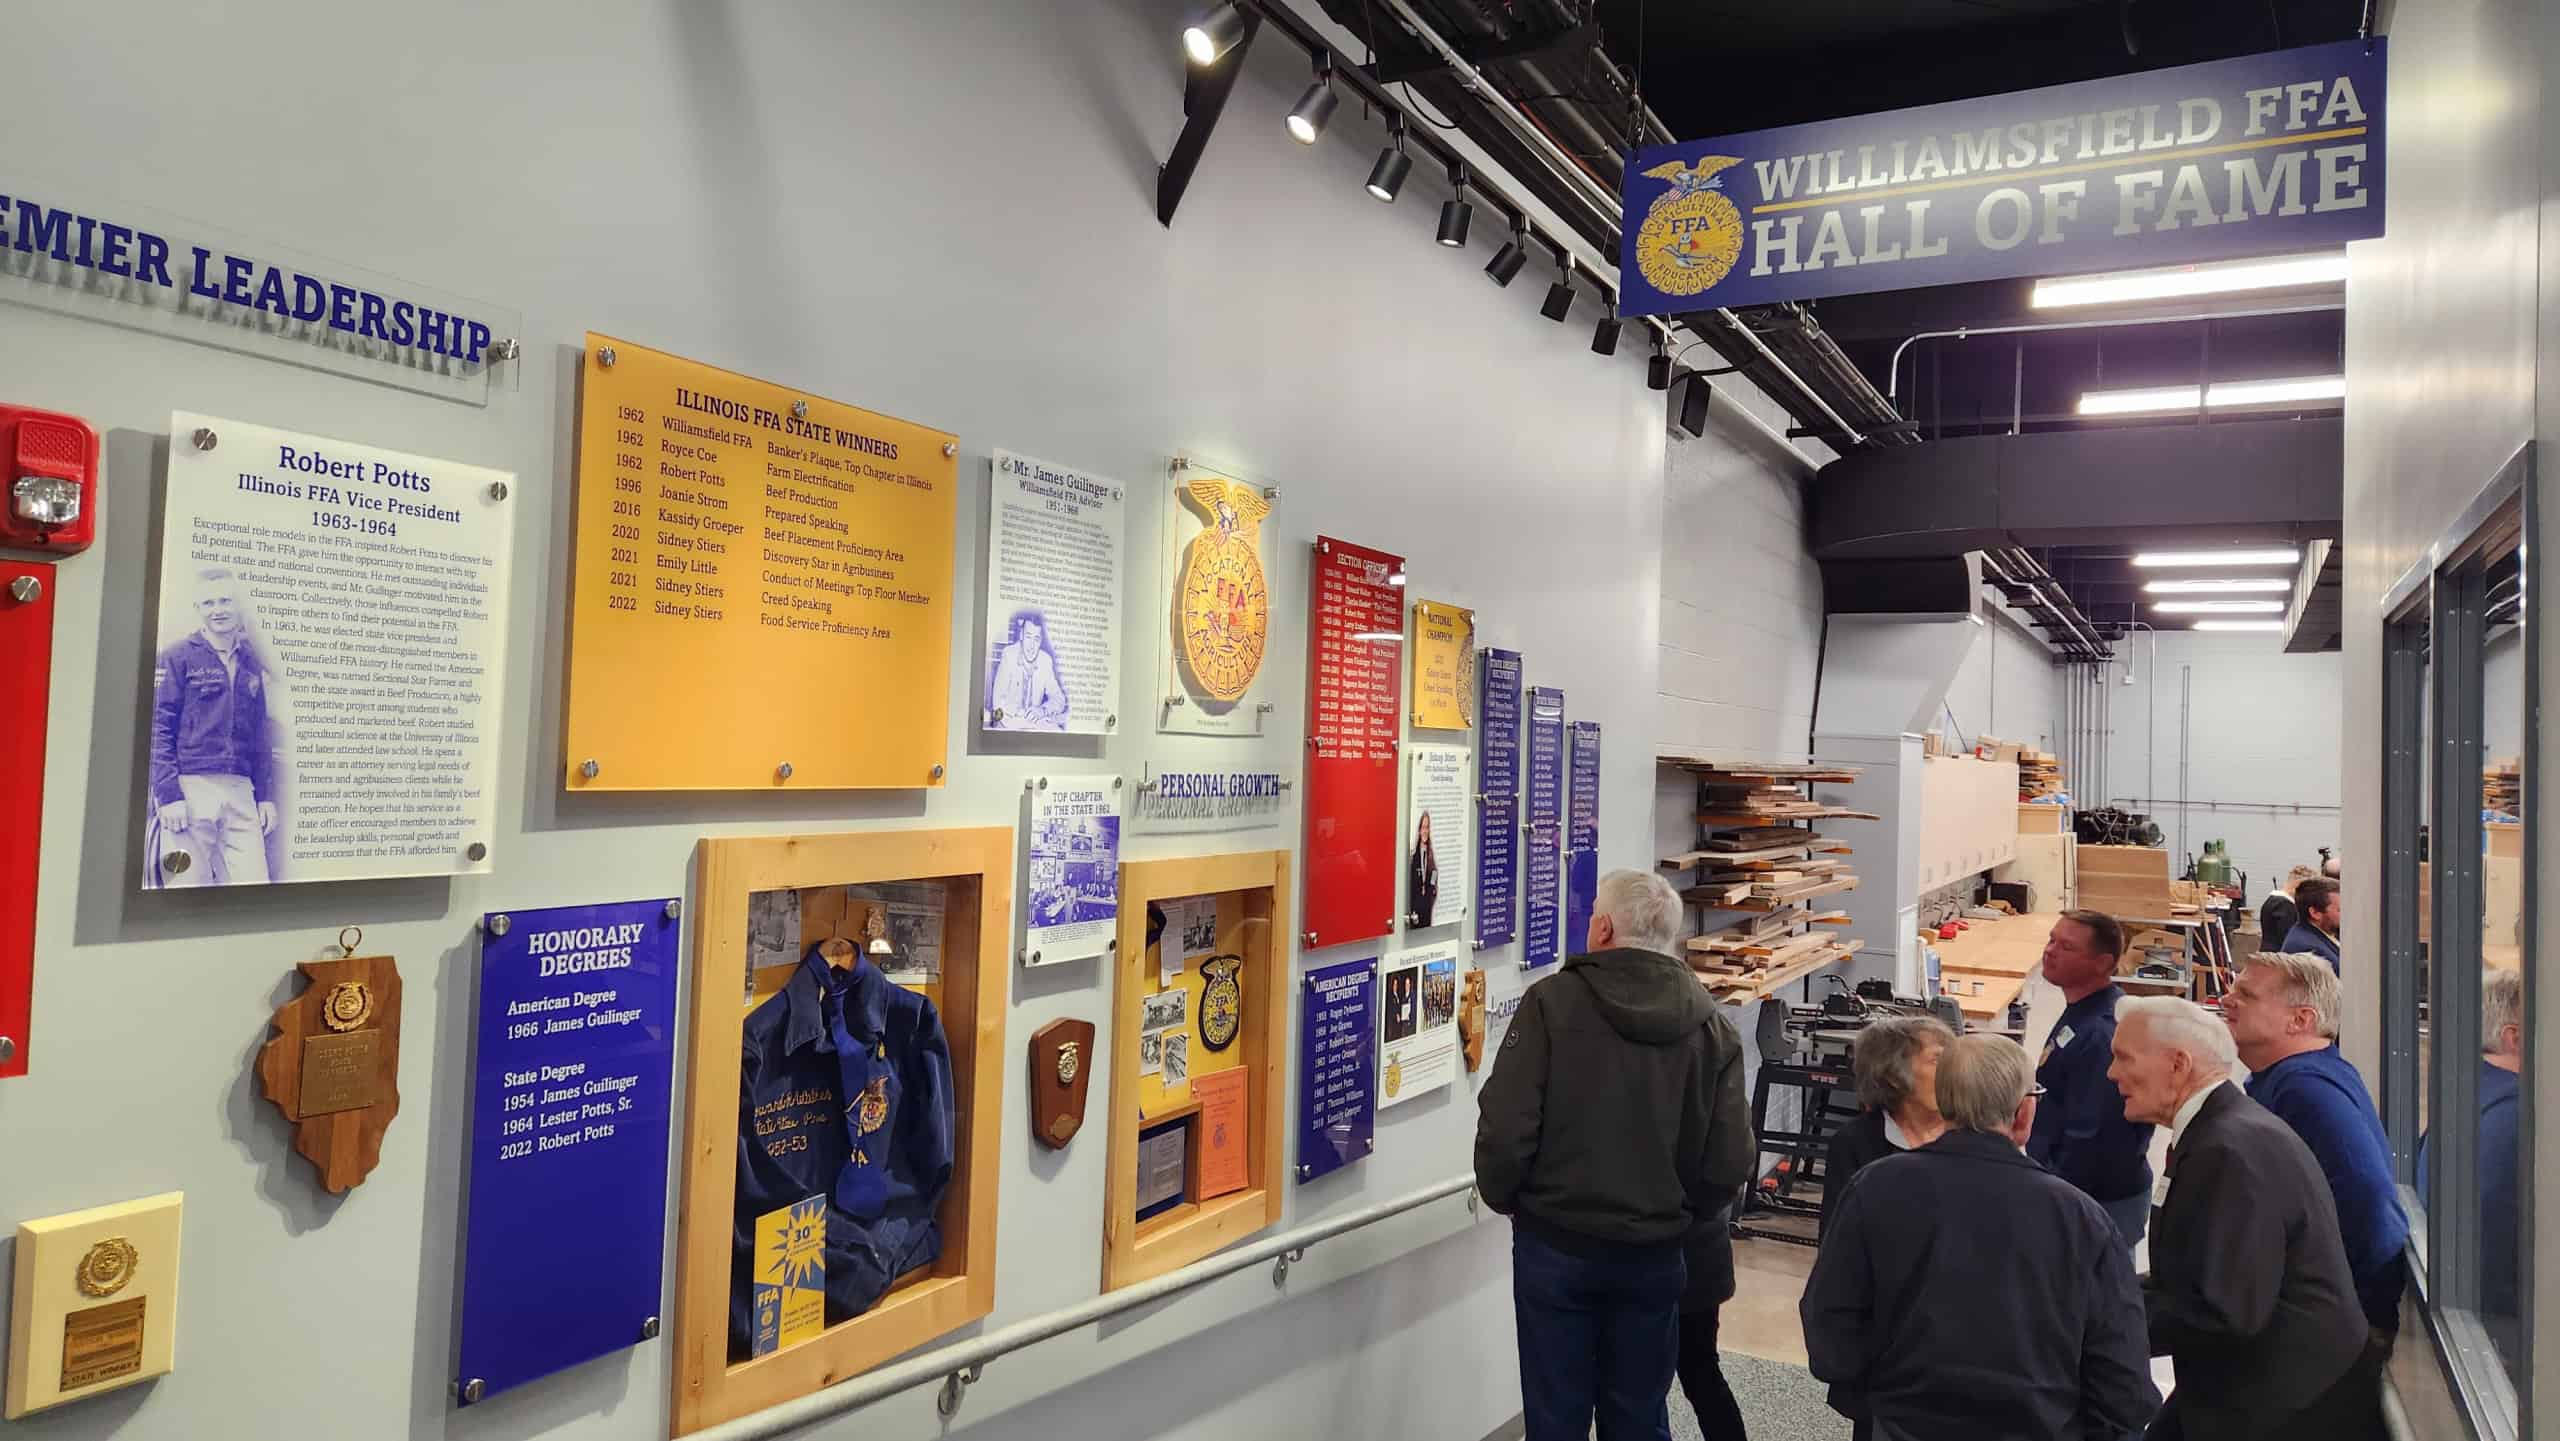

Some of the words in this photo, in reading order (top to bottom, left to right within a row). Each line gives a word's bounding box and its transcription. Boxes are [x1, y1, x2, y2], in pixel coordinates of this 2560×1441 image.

[1754, 97, 2224, 202] WILLIAMSFIELD
[2244, 76, 2367, 135] FFA
[1671, 216, 1711, 234] FFA
[1750, 200, 1949, 277] HALL
[1975, 180, 2086, 250] OF
[2112, 144, 2367, 236] FAME
[190, 246, 491, 363] LEADERSHIP
[676, 388, 749, 422] ILLINOIS
[754, 408, 781, 430] FFA
[785, 416, 831, 443] STATE
[835, 430, 898, 460] WINNERS
[617, 430, 643, 446] 1962
[662, 439, 694, 458] Royce
[697, 448, 717, 463] Coe
[768, 463, 790, 479] Farm
[794, 469, 854, 492] Electrification
[618, 406, 644, 423] 1962
[663, 415, 730, 444] Williamsfield
[733, 433, 752, 448] FFA
[768, 441, 807, 462] Banker's
[810, 451, 842, 470] Plaque,
[845, 460, 860, 474] Top
[864, 464, 895, 483] Chapter
[897, 472, 905, 483] in
[907, 475, 933, 491] Illinois
[278, 445, 364, 482] Robert
[373, 462, 431, 493] Potts
[616, 453, 642, 470] 1962
[660, 462, 696, 481] Robert
[700, 471, 725, 487] Potts
[766, 484, 787, 498] Beef
[789, 489, 838, 510] Production
[1014, 460, 1031, 477] Mr.
[1034, 466, 1064, 486] James
[1067, 474, 1108, 498] Guilinger
[238, 474, 301, 499] Illinois
[308, 485, 340, 505] FFA
[347, 491, 382, 512] Vice
[388, 498, 460, 522] President
[616, 477, 641, 493] 1996
[659, 485, 694, 504] Joanie
[698, 493, 728, 510] Strom
[765, 506, 806, 525] Prepared
[809, 514, 849, 535] Speaking
[194, 517, 250, 534] Exceptional
[253, 526, 270, 537] role
[273, 529, 305, 541] models
[308, 534, 316, 544] in
[319, 535, 332, 544] the
[335, 537, 352, 547] FFA
[311, 512, 397, 537] 1963-1964
[613, 500, 641, 517] 2016
[658, 508, 700, 530] Kassidy
[703, 516, 744, 535] Groeper
[764, 528, 784, 542] Beef
[788, 533, 834, 551] Placement
[837, 540, 883, 560] Proficiency
[886, 550, 904, 562] Area
[193, 533, 207, 544] full
[257, 541, 274, 552] The
[278, 544, 296, 555] FFA
[298, 550, 319, 558] gave
[321, 550, 337, 560] him
[340, 553, 354, 562] the
[405, 562, 413, 570] to
[612, 524, 640, 540] 2020
[658, 531, 694, 550] Sidney
[697, 538, 726, 554] Stiers
[764, 549, 809, 569] Discovery
[812, 557, 828, 569] Star
[832, 560, 839, 572] in
[843, 563, 894, 580] Agribusiness
[610, 572, 637, 587] 2021
[656, 578, 692, 597] Sidney
[695, 583, 723, 598] Stiers
[762, 592, 788, 606] Creed
[791, 595, 832, 615] Speaking
[612, 548, 638, 564] 2021
[657, 555, 687, 574] Emily
[691, 560, 718, 575] Little
[762, 570, 800, 586] Conduct
[804, 577, 814, 588] of
[816, 578, 854, 597] Meetings
[857, 584, 872, 599] Top
[875, 587, 896, 600] Floor
[898, 590, 930, 605] Member
[1217, 578, 1245, 608] FFA
[609, 595, 637, 610] 2022
[655, 601, 691, 619] Sidney
[694, 606, 723, 620] Stiers
[761, 613, 784, 626] Food
[787, 616, 819, 631] Service
[822, 620, 869, 639] Proficiency
[872, 627, 890, 639] Area
[1053, 793, 1068, 802] TOP
[1069, 792, 1102, 802] CHAPTER
[1161, 774, 1225, 797] PERSONAL
[1230, 774, 1279, 797] GROWTH
[1044, 806, 1051, 816] IN
[1055, 806, 1068, 815] THE
[1071, 805, 1092, 815] STATE
[528, 924, 644, 954] HONORARY
[540, 948, 632, 977] DEGREES
[507, 996, 570, 1016] American
[573, 990, 616, 1009] Degree
[1315, 976, 1346, 993] AMERICAN
[1326, 986, 1359, 1003] RECIPIENTS
[508, 1022, 538, 1039] 1966
[543, 1018, 584, 1034] James
[587, 1008, 642, 1028] Guilinger
[504, 1071, 537, 1088] State
[541, 1062, 585, 1082] Degree
[504, 1096, 534, 1111] 1954
[540, 1088, 580, 1105] James
[584, 1074, 638, 1096] Guilinger
[503, 1120, 533, 1136] 1964
[540, 1110, 578, 1128] Lester
[581, 1102, 614, 1118] Potts,
[618, 1098, 632, 1111] Sr.
[500, 1142, 532, 1160] 2022
[539, 1134, 580, 1152] Robert
[584, 1124, 614, 1140] Potts
[758, 1288, 779, 1308] FFA
